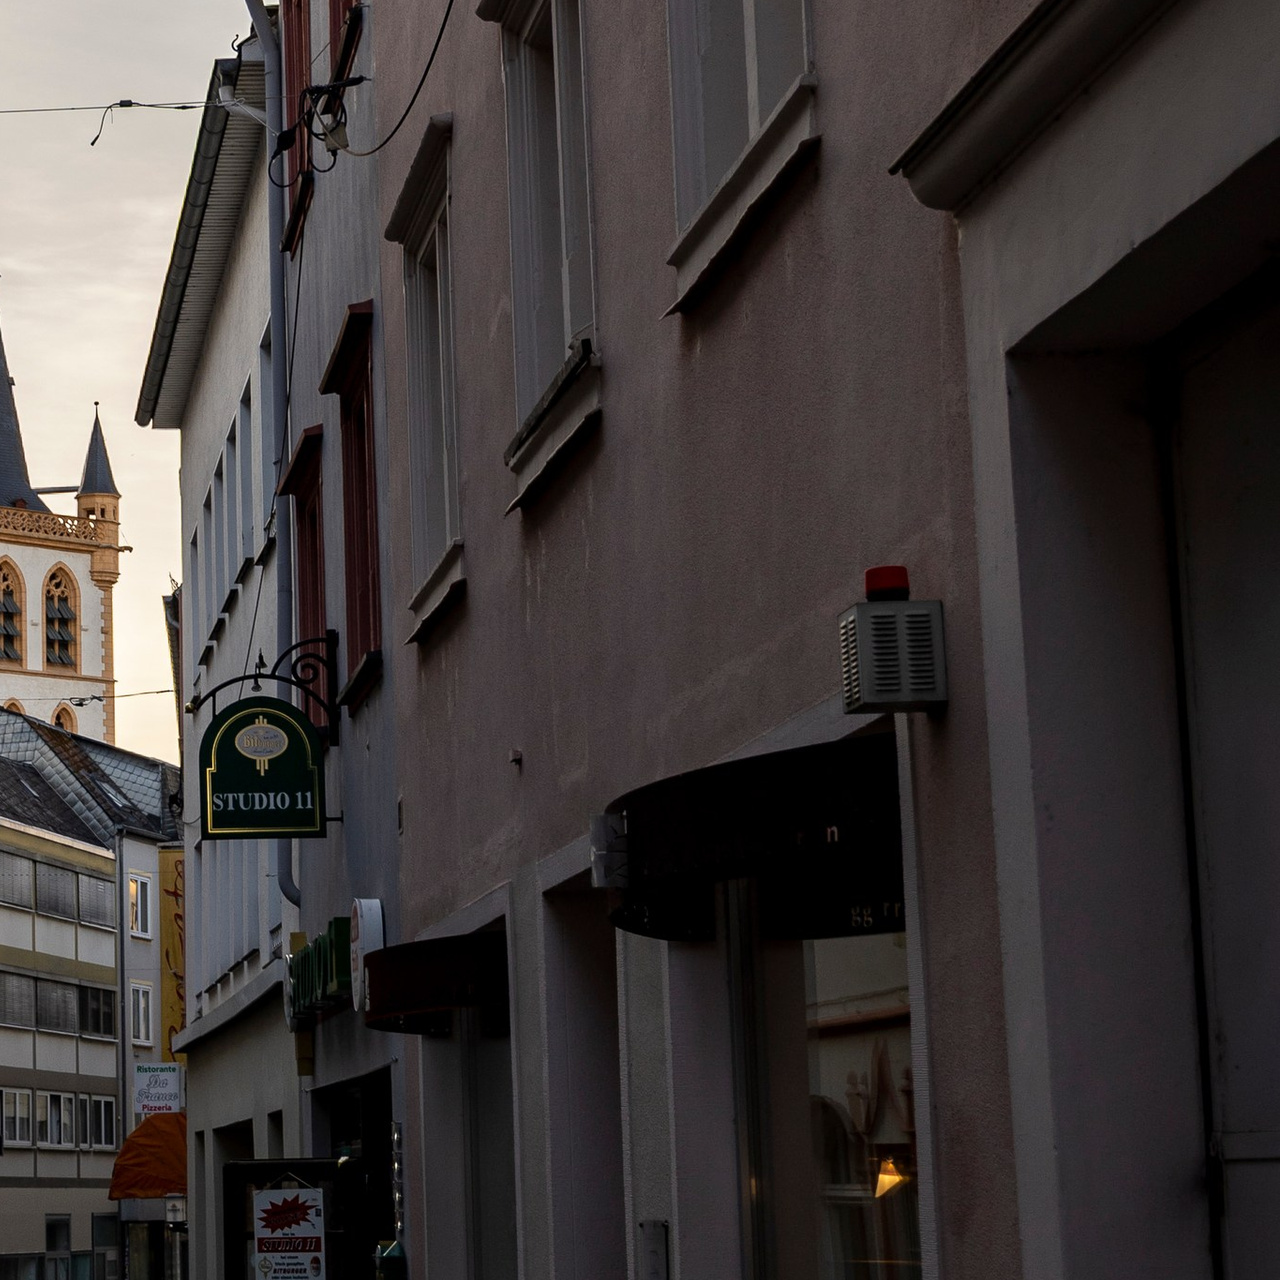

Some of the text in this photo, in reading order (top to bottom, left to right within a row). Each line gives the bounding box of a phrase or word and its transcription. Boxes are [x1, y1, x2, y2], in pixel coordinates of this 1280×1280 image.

[212, 790, 314, 811] STUDIO 11
[136, 1065, 177, 1073] Ristorante
[146, 1074, 169, 1089] Da
[136, 1088, 179, 1103] Franco
[262, 1238, 303, 1251] STUDIO
